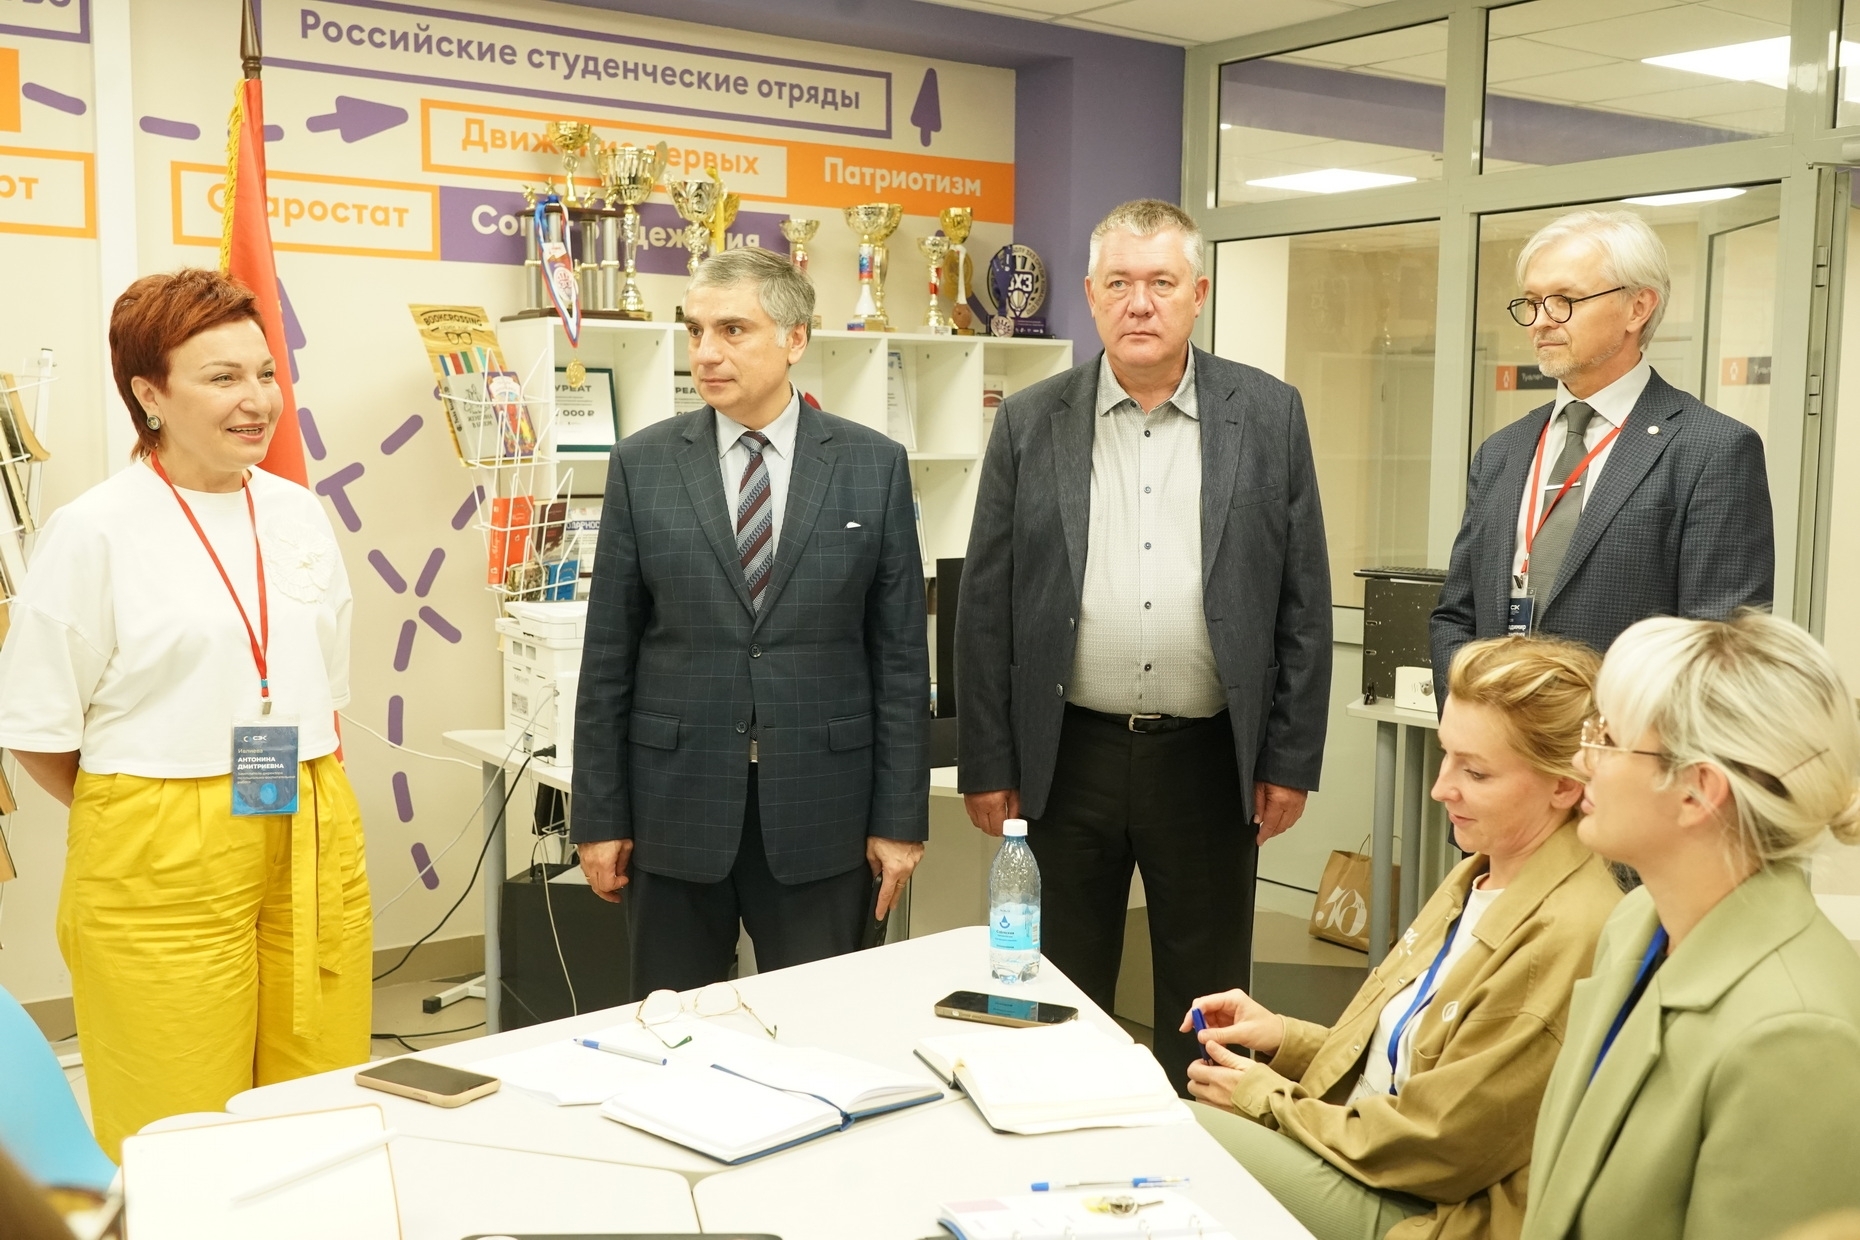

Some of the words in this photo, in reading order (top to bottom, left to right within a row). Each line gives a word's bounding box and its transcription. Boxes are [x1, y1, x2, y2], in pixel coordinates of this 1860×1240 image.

[301, 9, 517, 66] Российские
[527, 47, 749, 96] студенческие
[757, 78, 860, 111] отряды
[824, 156, 982, 197] Патриотизм
[207, 182, 410, 228] Саростат
